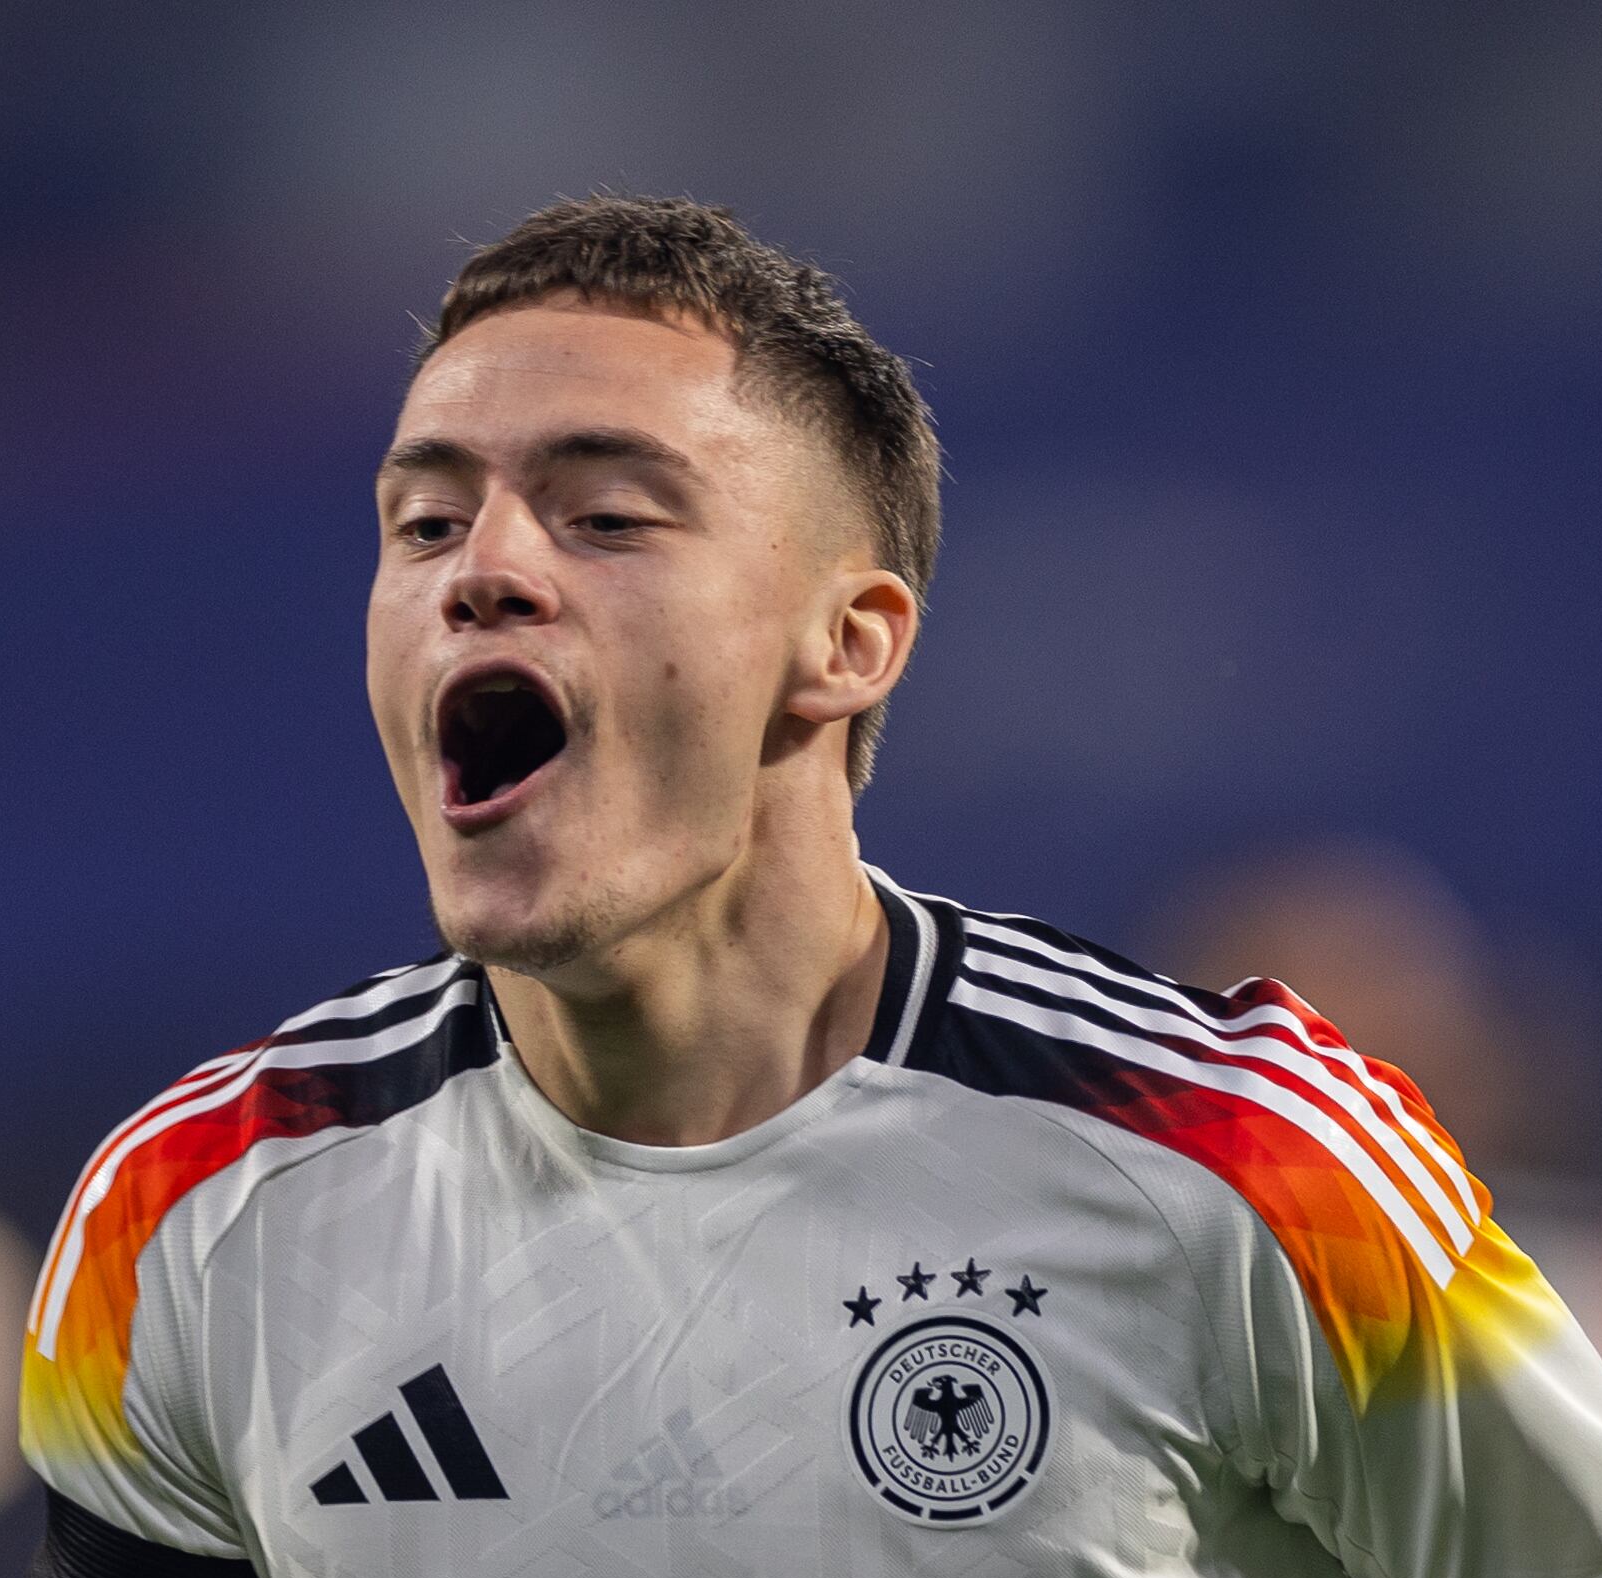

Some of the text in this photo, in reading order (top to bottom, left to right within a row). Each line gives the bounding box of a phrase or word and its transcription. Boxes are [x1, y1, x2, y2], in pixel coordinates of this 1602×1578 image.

[889, 1343, 1001, 1384] DEUTSCHER
[881, 1433, 1020, 1494] FUSSBALL-BUND
[591, 1476, 750, 1519] adidas
